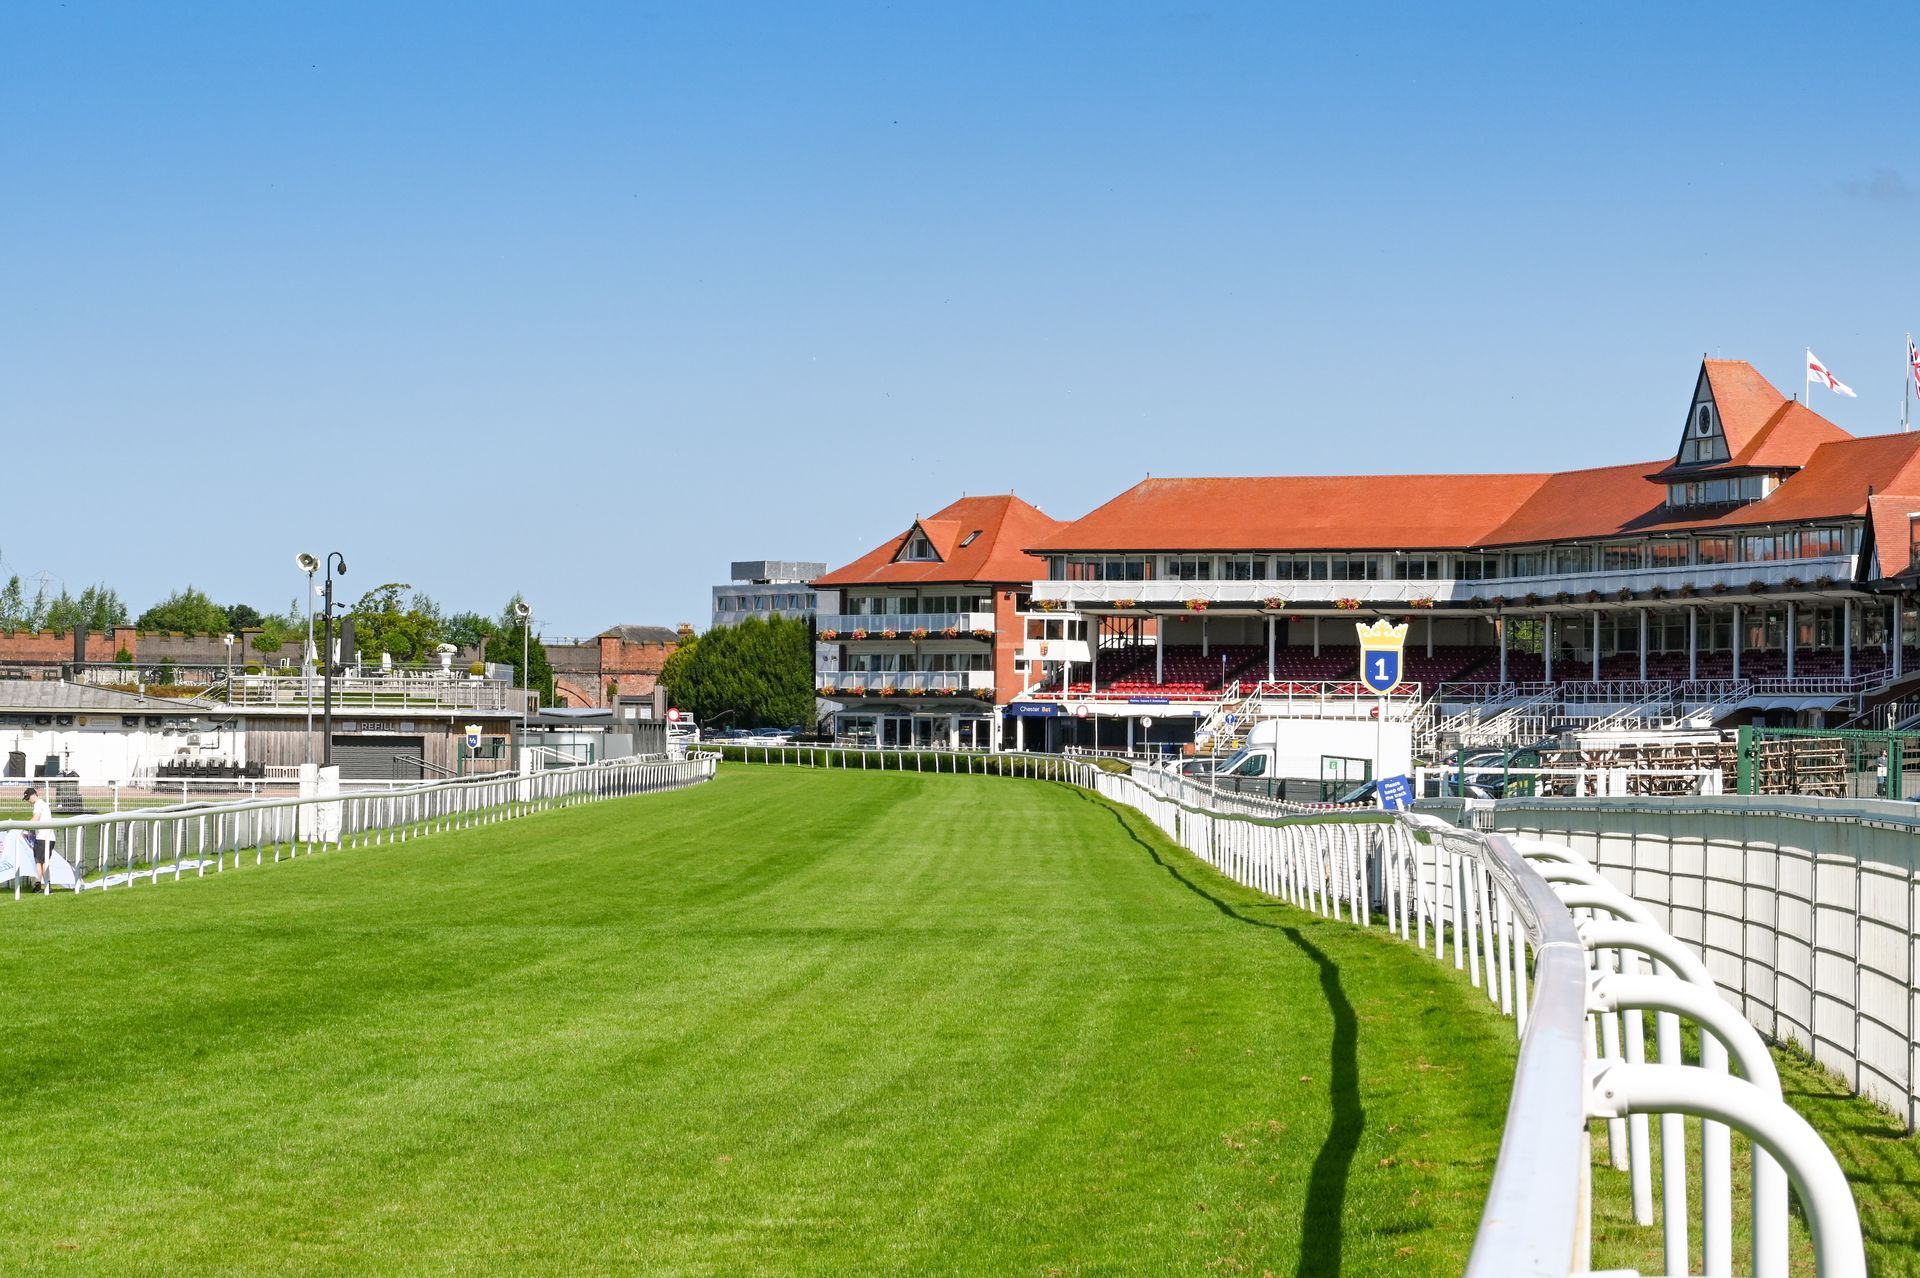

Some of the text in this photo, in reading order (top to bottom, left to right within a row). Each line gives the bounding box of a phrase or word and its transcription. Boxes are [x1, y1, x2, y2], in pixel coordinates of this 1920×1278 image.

[1374, 657, 1389, 681] 1
[361, 722, 395, 730] REFILL
[1384, 781, 1401, 789] Please
[1393, 790, 1407, 798] track
